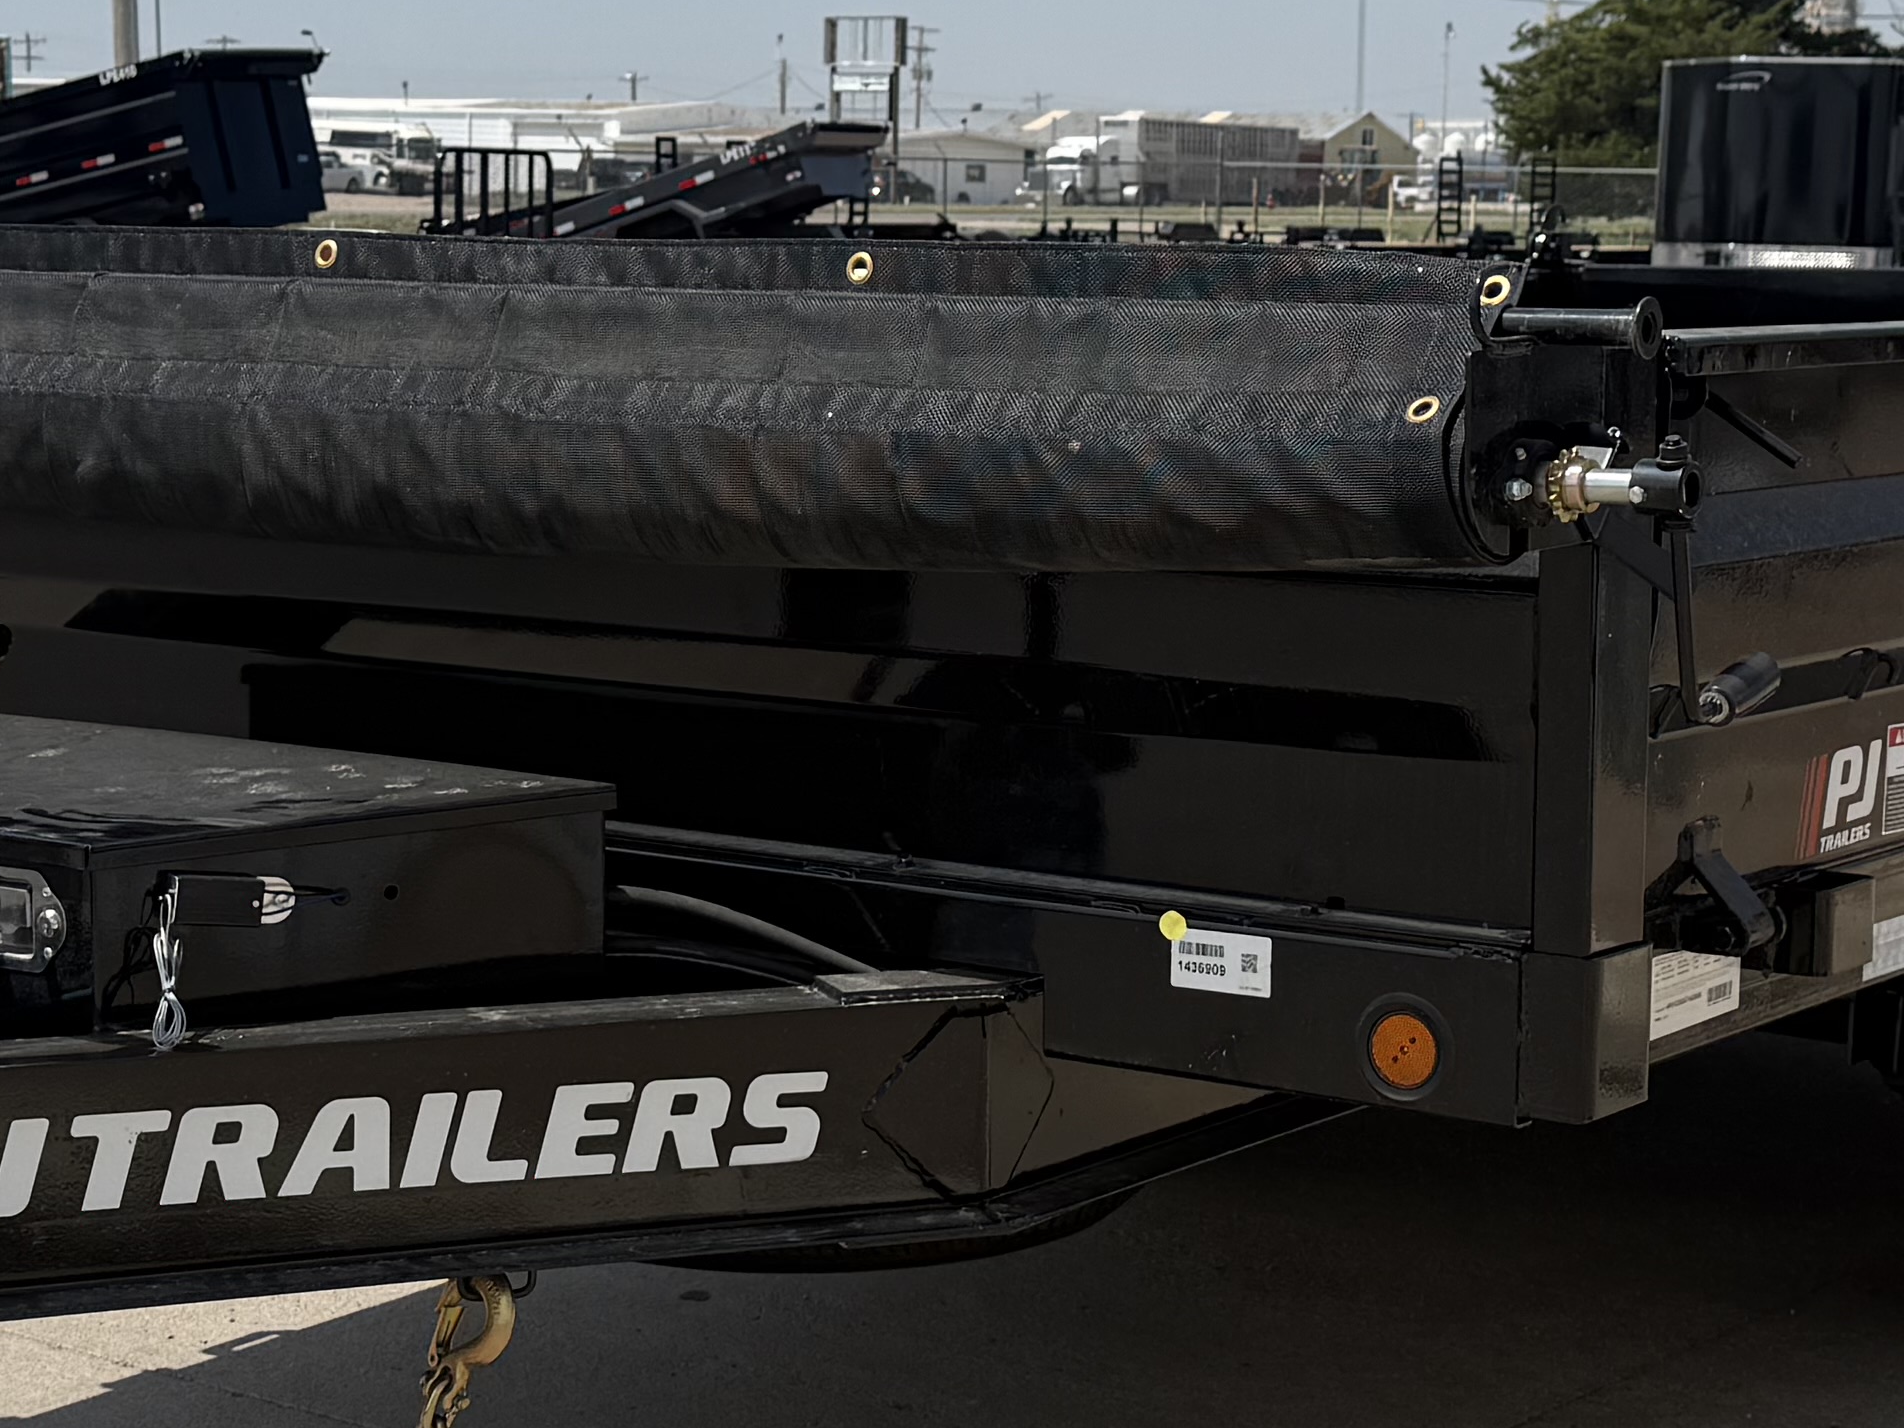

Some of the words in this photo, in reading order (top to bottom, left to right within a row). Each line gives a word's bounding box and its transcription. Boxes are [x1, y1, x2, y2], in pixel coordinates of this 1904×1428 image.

[1822, 739, 1883, 830] PJ
[1820, 822, 1871, 854] TRAILERS
[70, 1071, 829, 1212] TRAILERS
